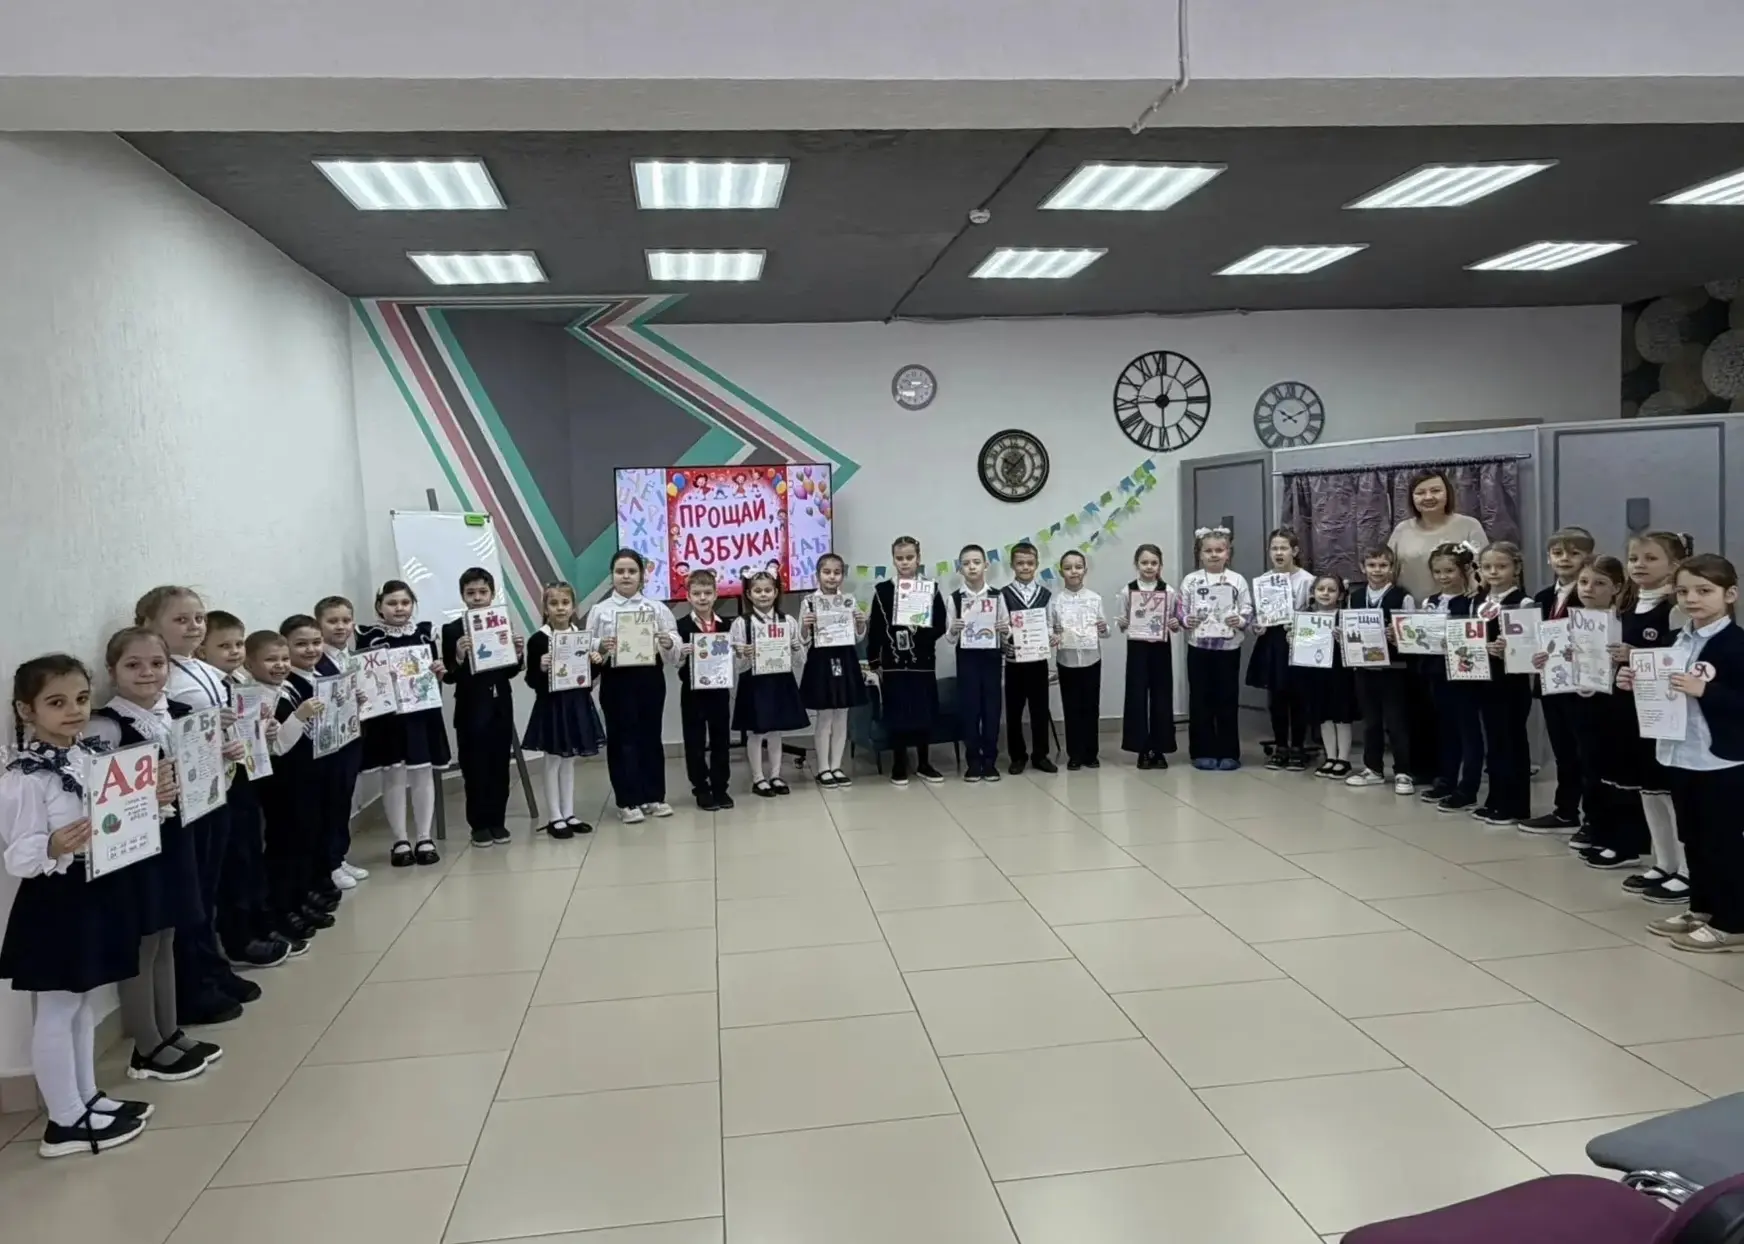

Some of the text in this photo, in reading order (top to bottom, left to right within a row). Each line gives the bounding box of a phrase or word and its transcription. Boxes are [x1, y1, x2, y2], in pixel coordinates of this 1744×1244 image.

[1132, 358, 1152, 381] XI
[1152, 352, 1167, 376] XII
[1174, 359, 1185, 378] I
[1120, 374, 1141, 390] X
[1184, 374, 1202, 388] II
[1117, 397, 1138, 410] IX
[1176, 423, 1190, 443] V
[680, 494, 774, 528] ПРОЩАЙ,
[684, 527, 779, 566] АЗБУКА!
[768, 623, 785, 639] Нн
[1310, 616, 1332, 628] Чч
[1465, 621, 1484, 639] Ы
[1635, 660, 1652, 673] Яя
[1695, 662, 1710, 679] Я
[96, 755, 156, 805] Аа
